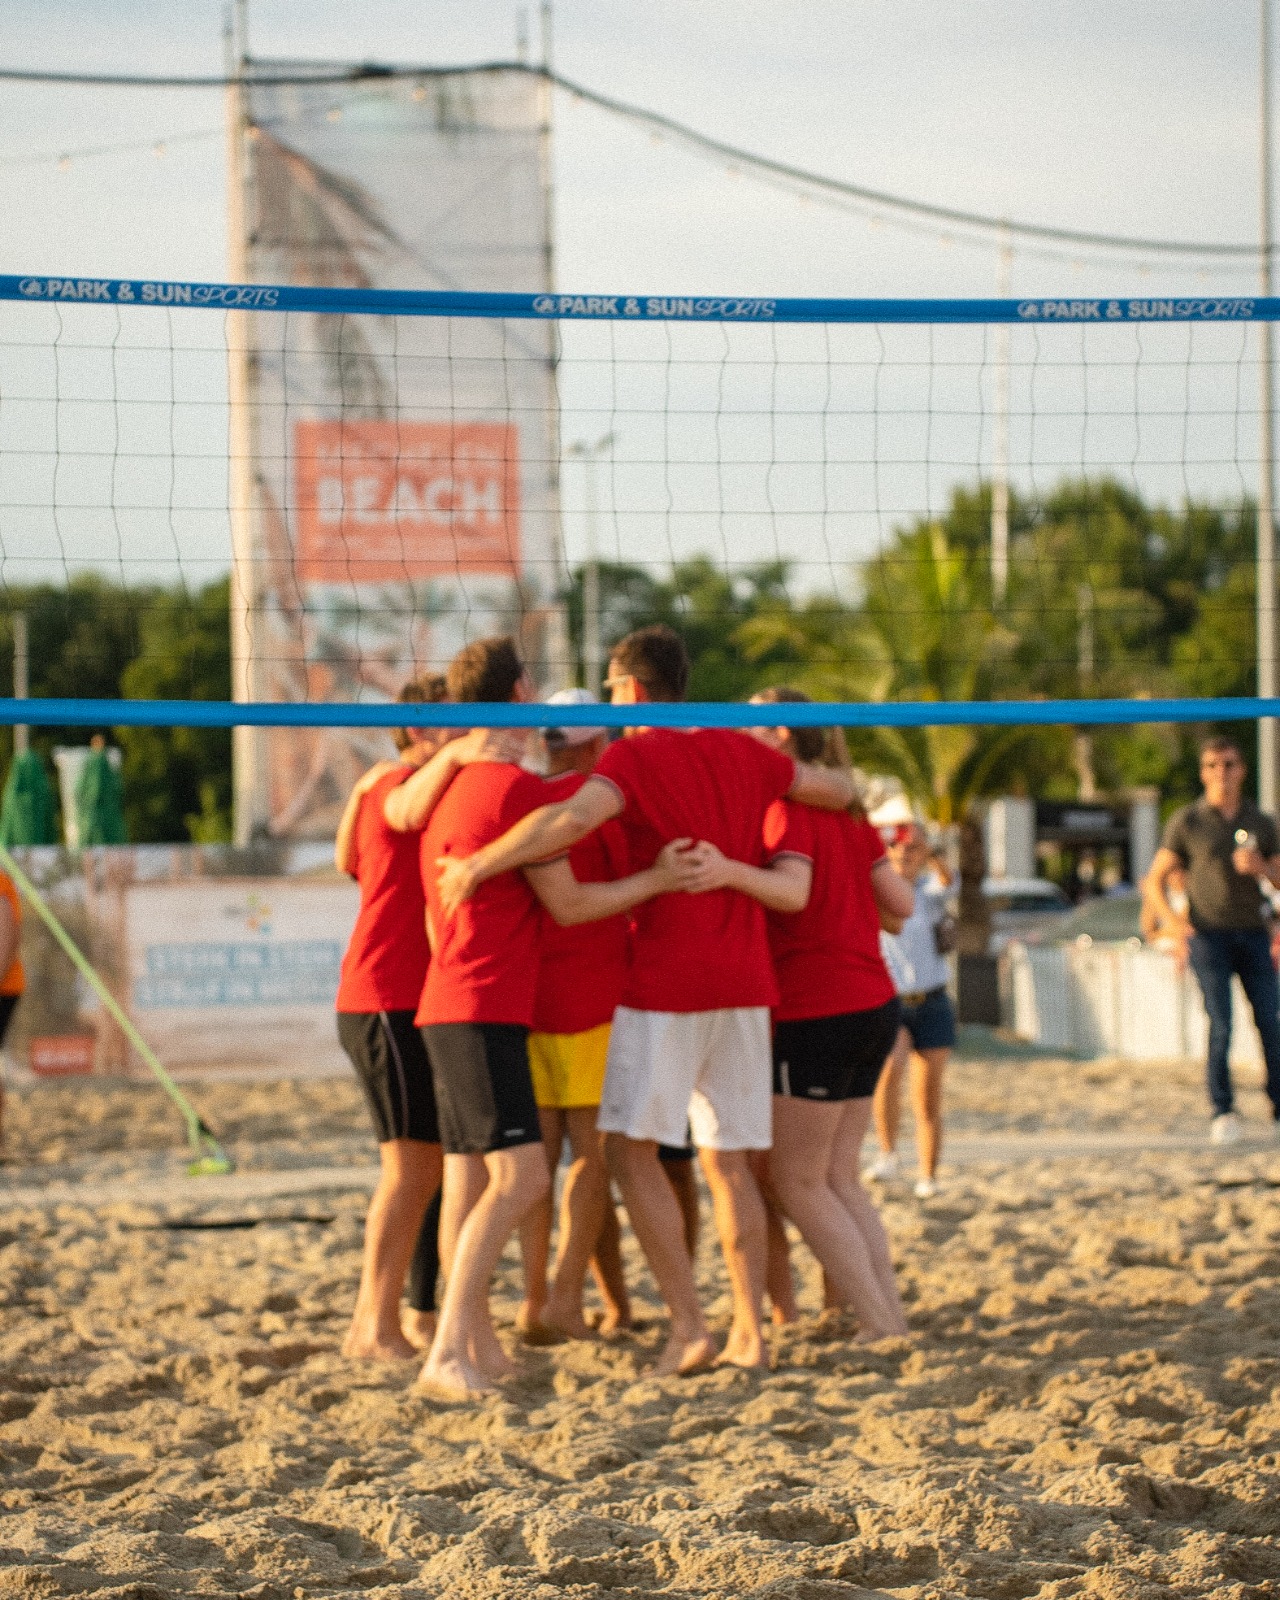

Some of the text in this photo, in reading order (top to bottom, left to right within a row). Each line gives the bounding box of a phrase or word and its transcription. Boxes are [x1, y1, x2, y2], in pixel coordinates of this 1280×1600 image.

[47, 279, 111, 300] PARK
[117, 283, 135, 301] &
[559, 297, 618, 315] PARK
[624, 298, 641, 316] &
[1043, 301, 1102, 318] PARK
[1106, 301, 1122, 318] &
[317, 476, 500, 525] BEACH
